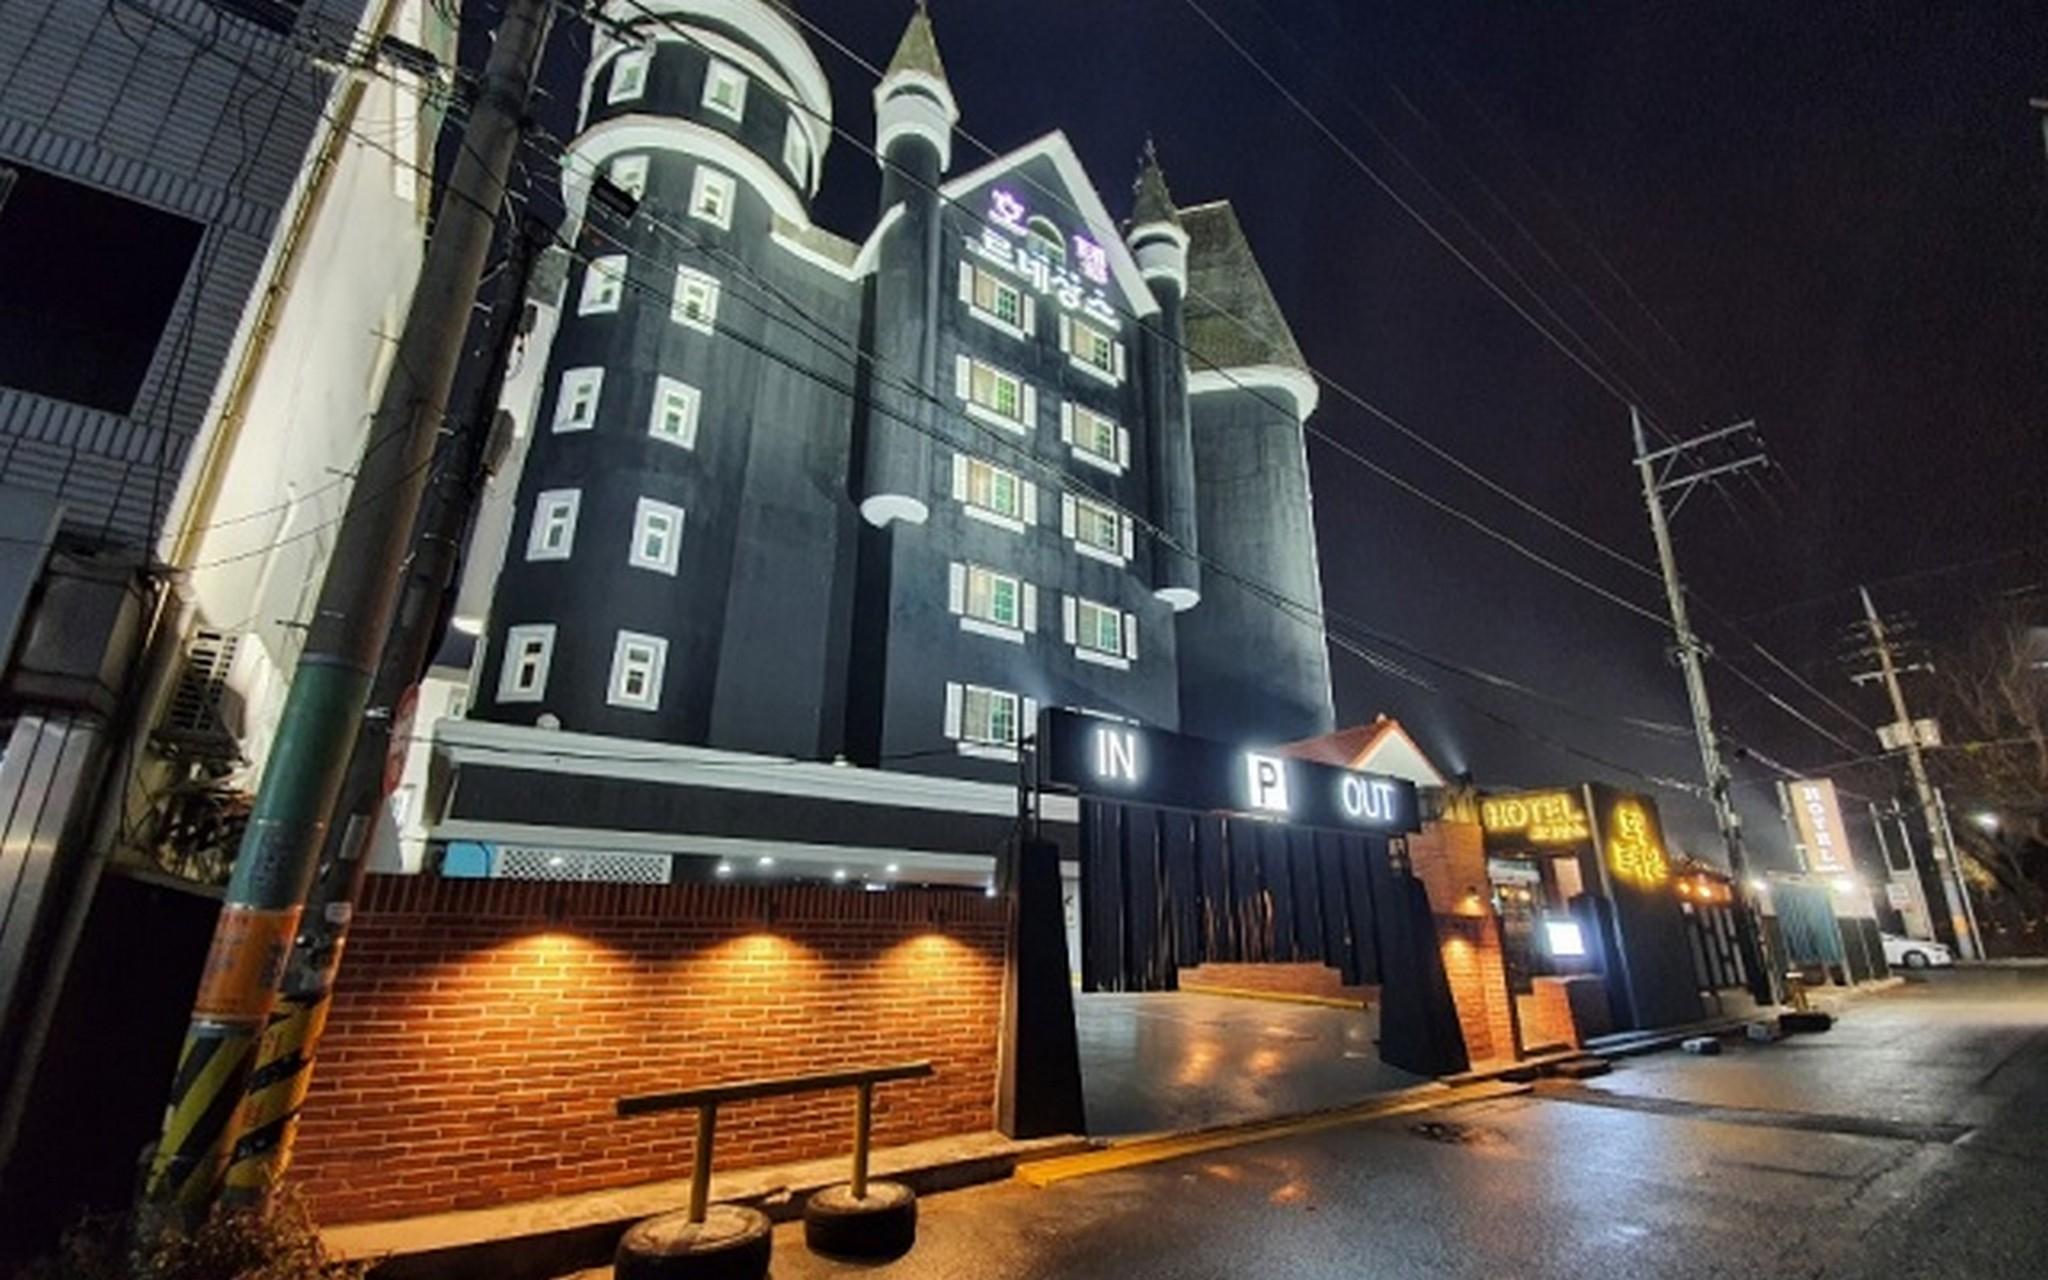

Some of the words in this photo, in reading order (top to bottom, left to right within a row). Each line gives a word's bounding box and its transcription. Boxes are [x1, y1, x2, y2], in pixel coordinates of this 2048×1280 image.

[964, 227, 1121, 331] 르네상스
[1097, 729, 1138, 780] IN
[1342, 777, 1394, 819] OUT
[1483, 795, 1583, 828] HOTEL
[1802, 787, 1835, 861] HOTEL
